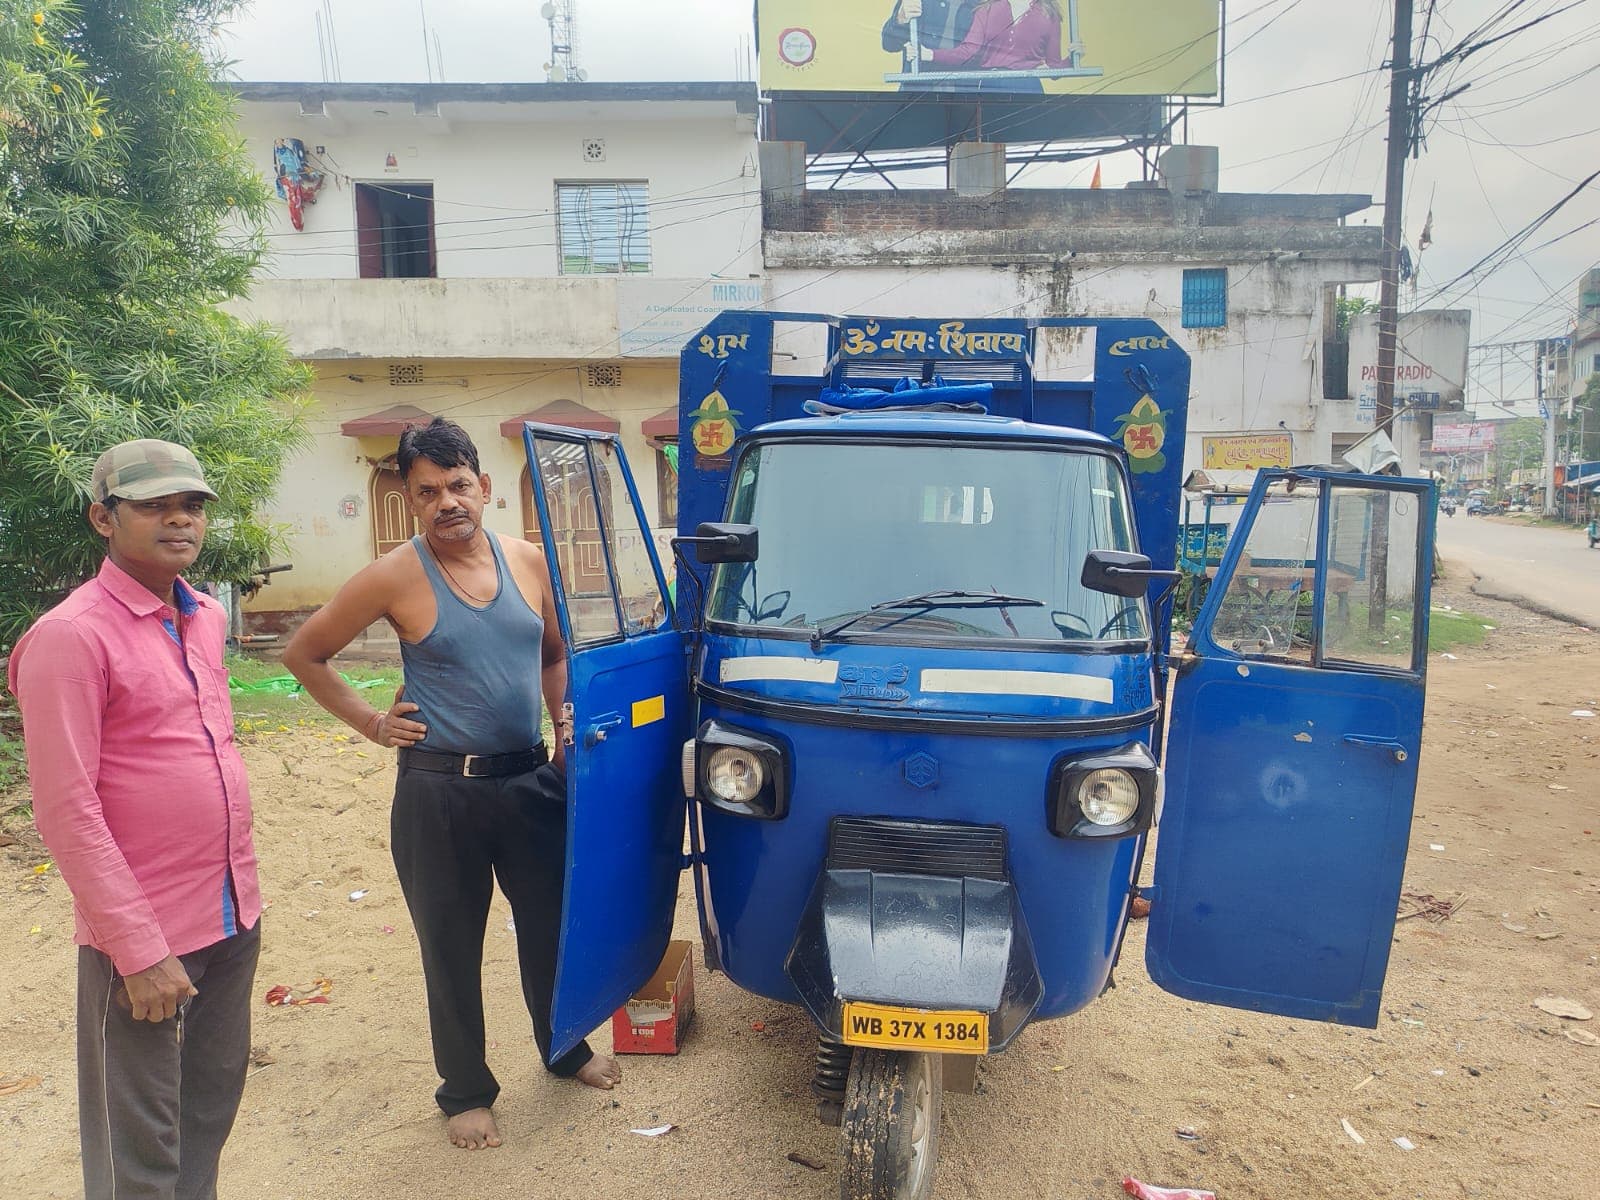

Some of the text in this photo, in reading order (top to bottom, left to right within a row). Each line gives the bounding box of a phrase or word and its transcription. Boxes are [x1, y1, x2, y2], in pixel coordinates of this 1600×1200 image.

[698, 334, 750, 359] शुभ
[936, 321, 1026, 356] शिवाय
[1109, 336, 1170, 356] लाभ
[1397, 366, 1432, 380] RADIO
[852, 1016, 980, 1041] WB 37X 1384
